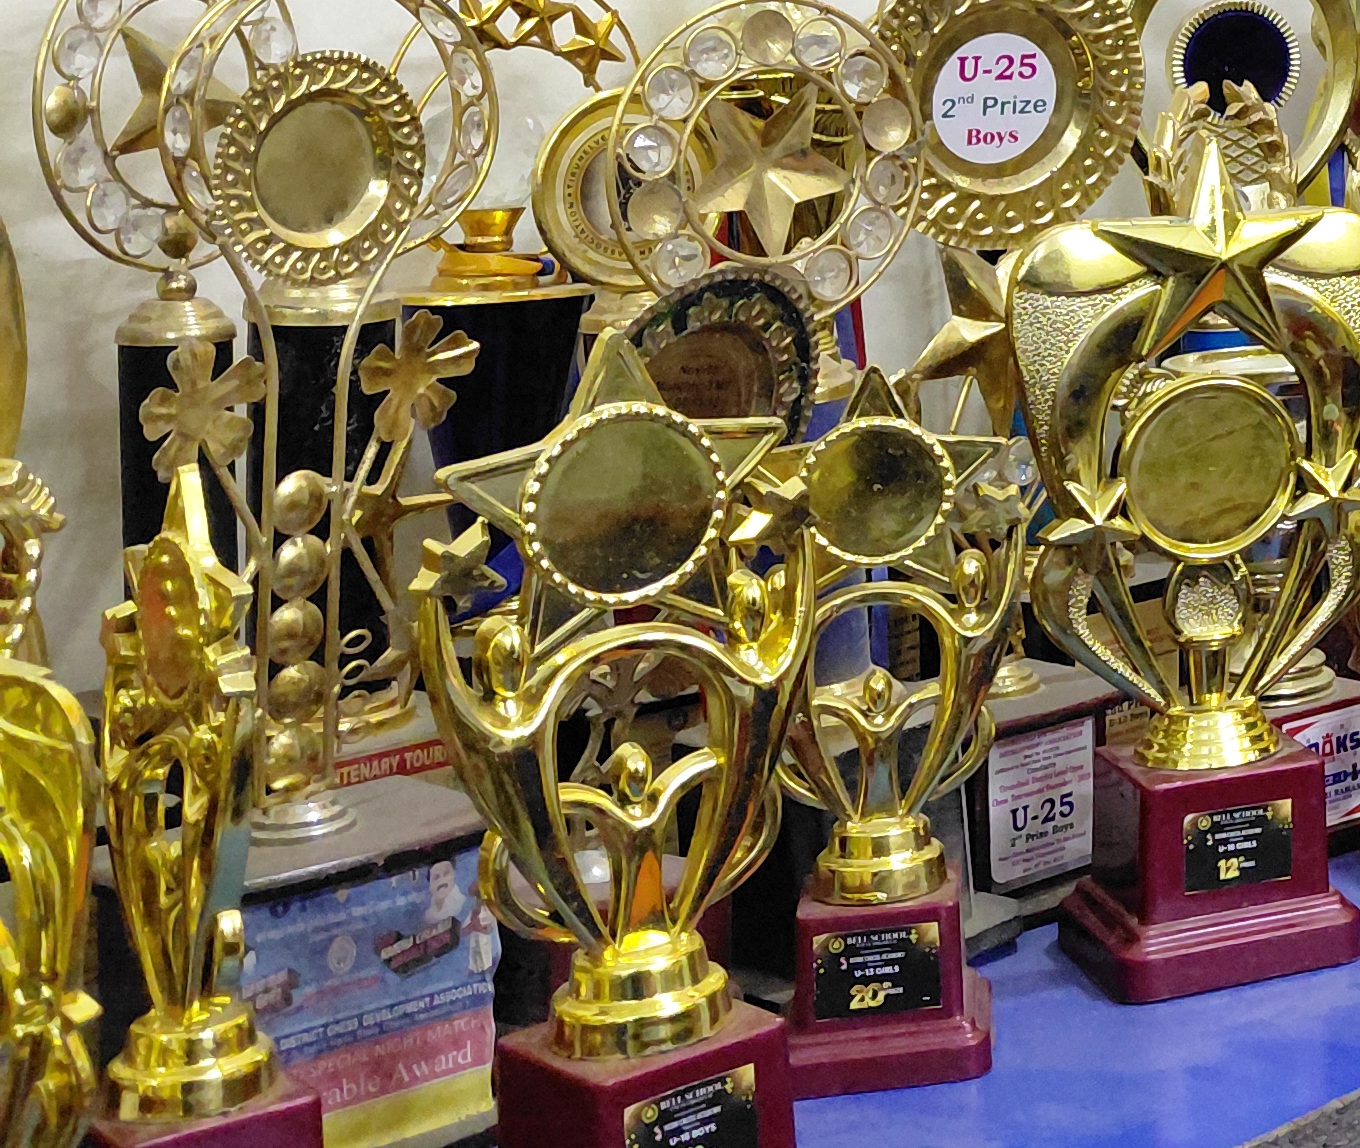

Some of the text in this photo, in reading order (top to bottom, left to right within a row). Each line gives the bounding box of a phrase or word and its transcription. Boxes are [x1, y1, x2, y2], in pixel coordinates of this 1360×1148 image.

[956, 53, 1038, 83] U-25
[941, 94, 1047, 118] 2nd Prize
[966, 128, 1019, 148] Boys
[1010, 791, 1074, 832] U-25
[1025, 830, 1049, 844] Prize
[1052, 821, 1075, 835] Boys
[280, 1028, 324, 1050] DISTRICT
[327, 1017, 358, 1036] CHESS
[310, 1016, 483, 1078] SPECIAL NIGHT MATCH
[323, 1040, 472, 1106] able Award
[691, 1122, 718, 1139] BOYS
